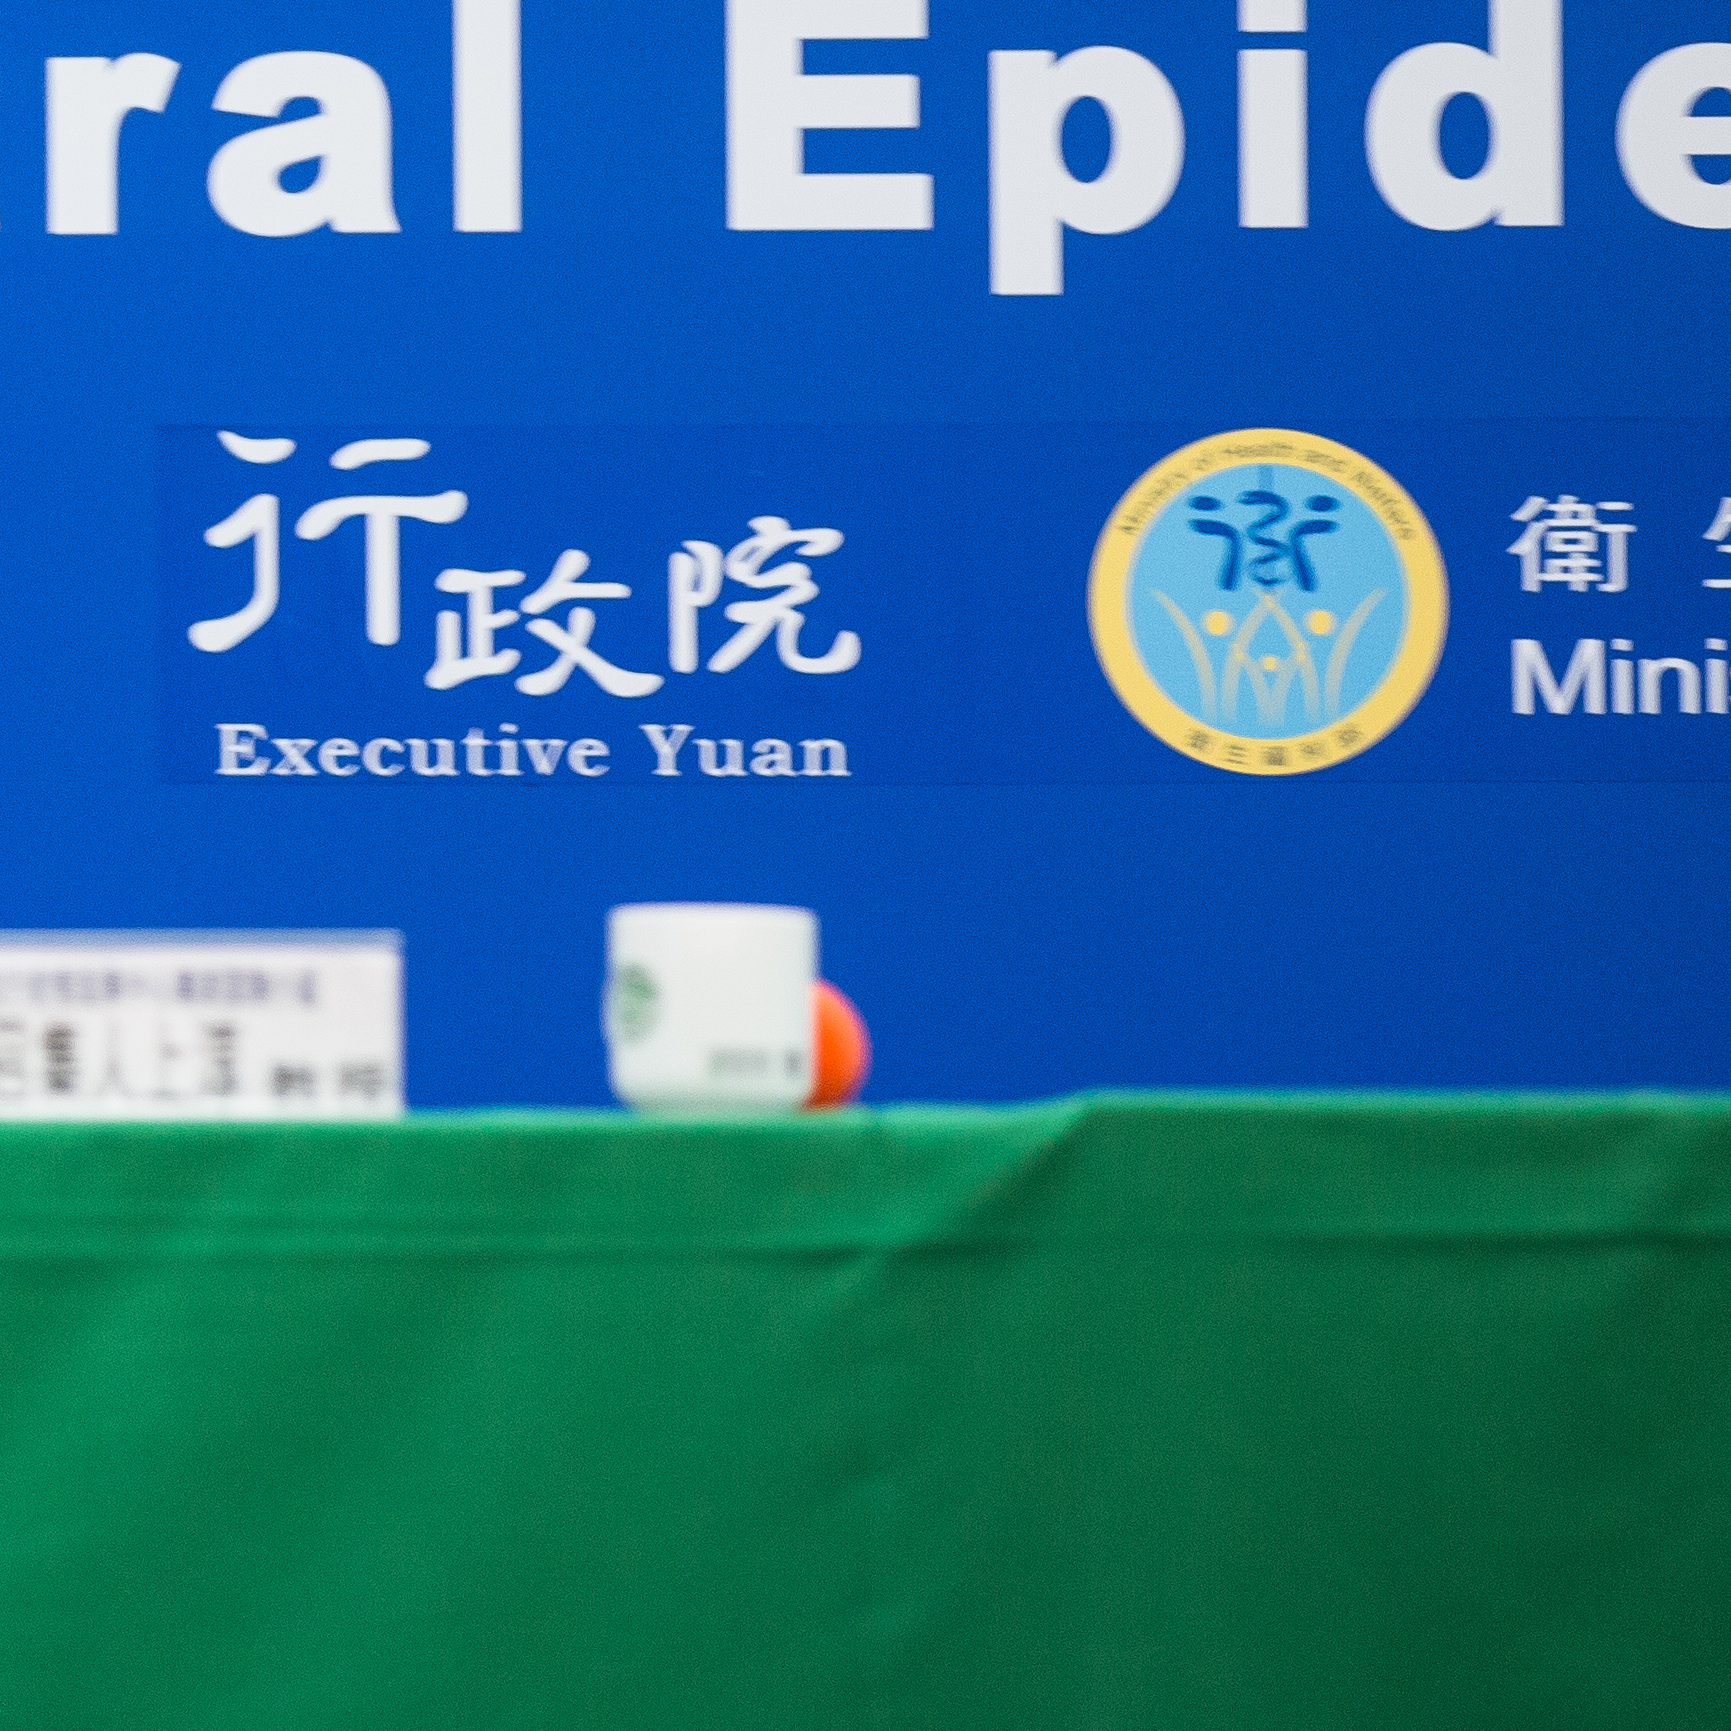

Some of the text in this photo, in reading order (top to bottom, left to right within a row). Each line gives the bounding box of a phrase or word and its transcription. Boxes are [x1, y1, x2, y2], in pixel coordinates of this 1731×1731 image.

[188, 431, 861, 698] 行政院
[1510, 637, 1731, 715] Mini
[215, 722, 850, 777] Executive Yuan
